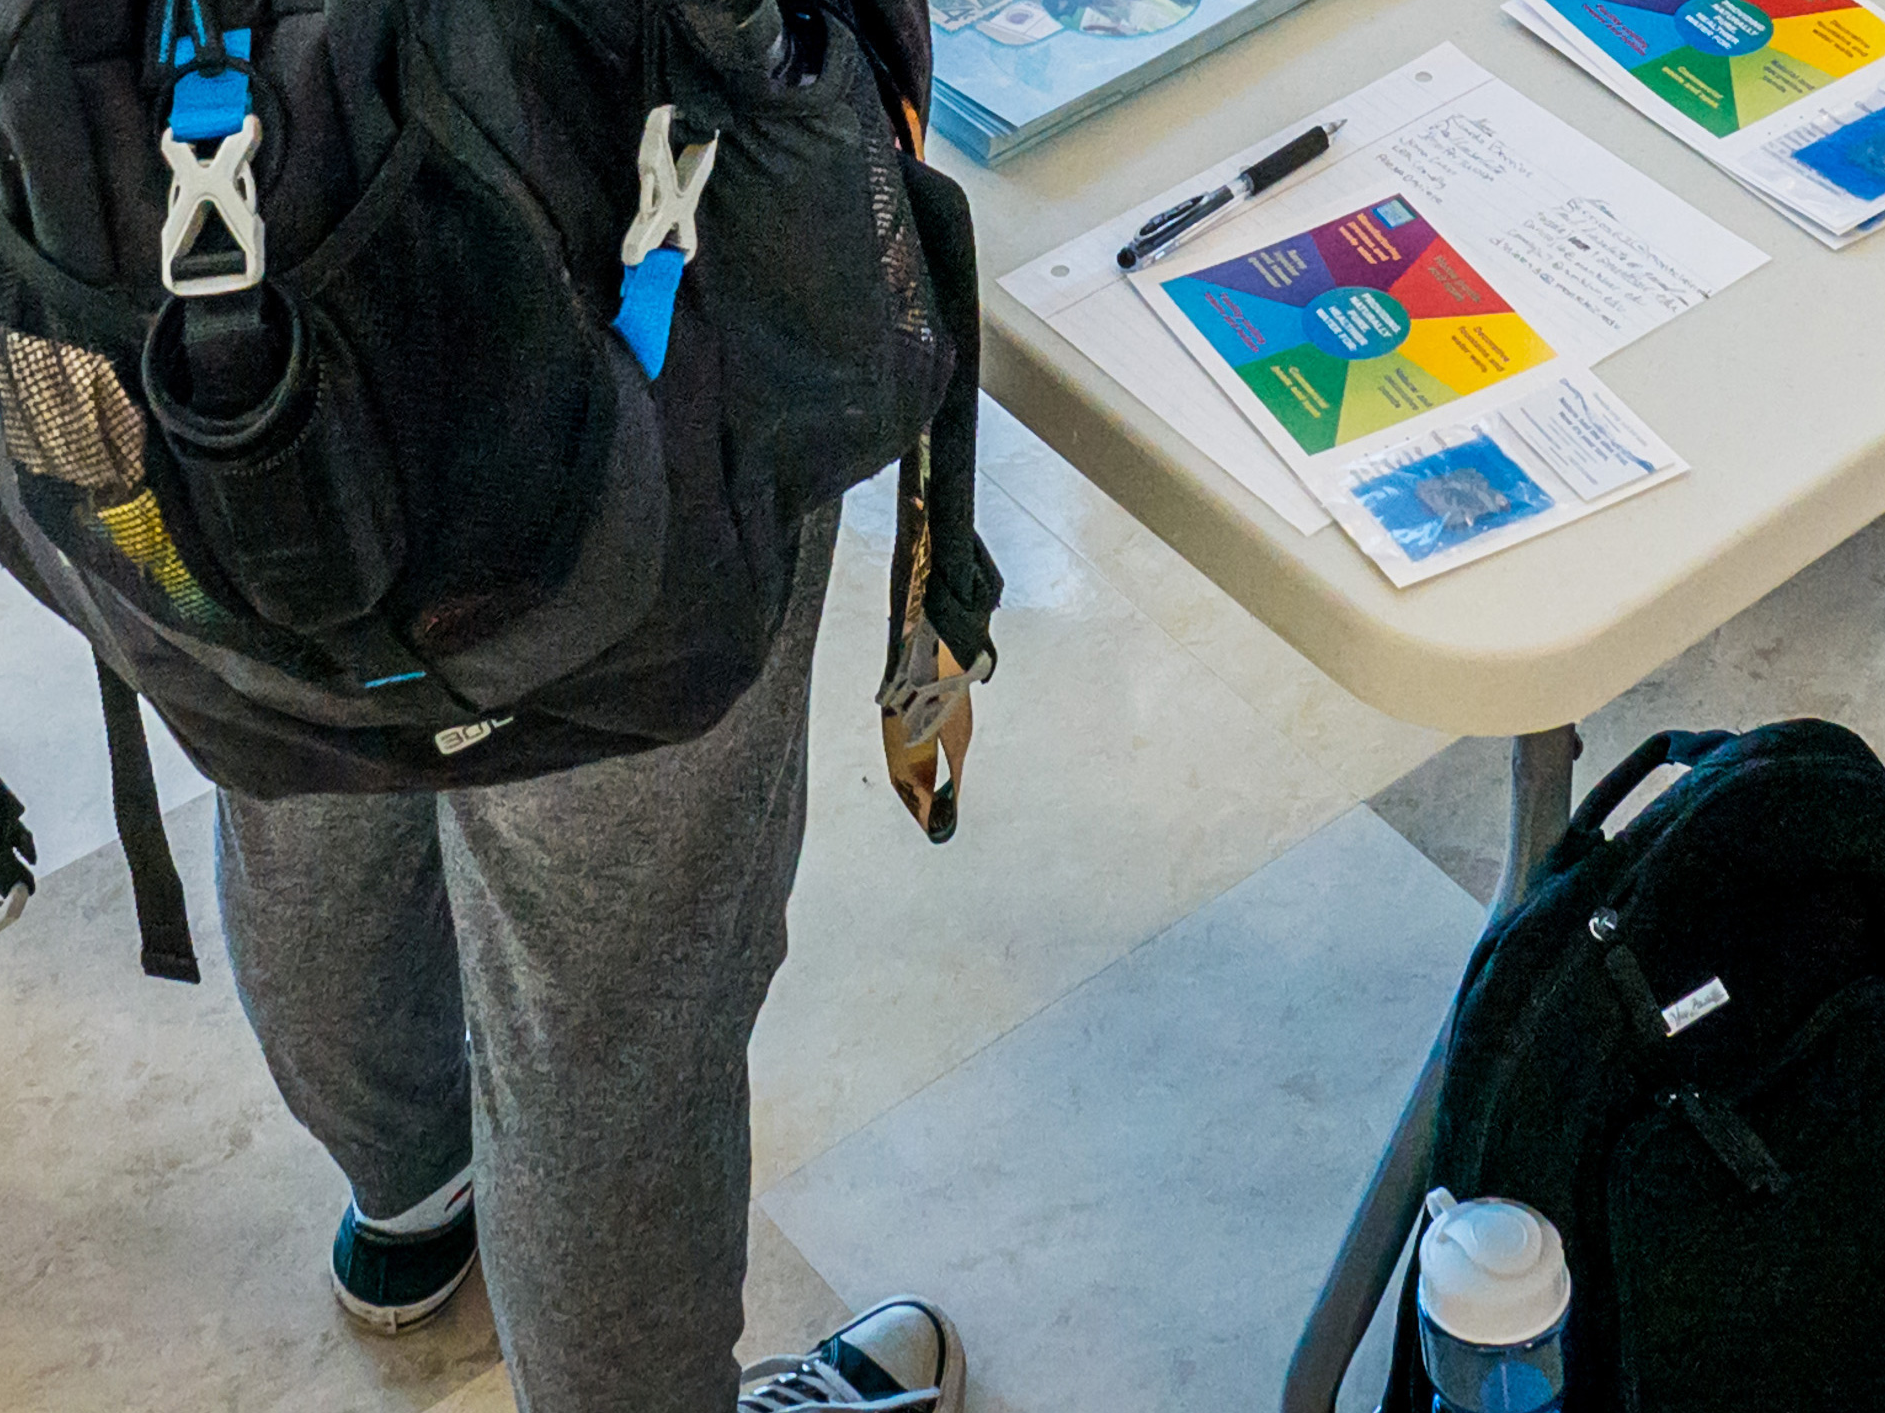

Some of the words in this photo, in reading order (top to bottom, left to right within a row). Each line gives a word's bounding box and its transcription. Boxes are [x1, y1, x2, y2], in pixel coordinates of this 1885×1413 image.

[1683, 14, 1714, 36] WATER
[1710, 2, 1759, 37] NATURALLY
[1313, 307, 1342, 334] WATER
[1348, 296, 1392, 337] NATURALLY
